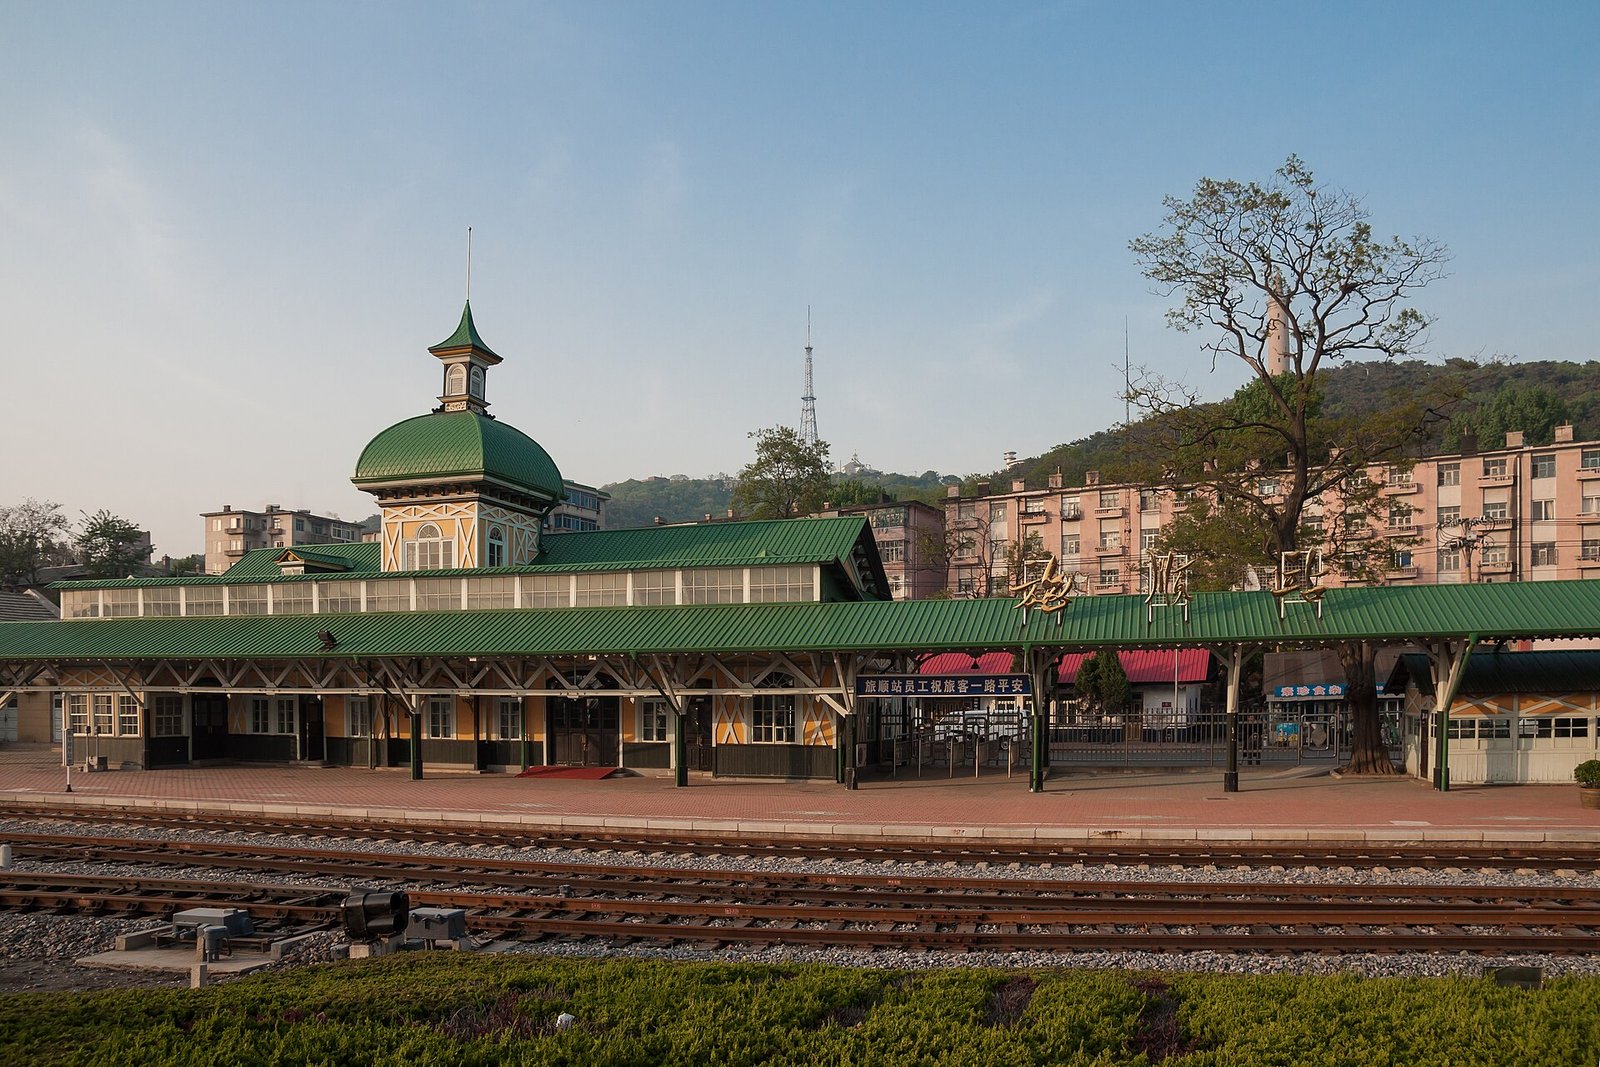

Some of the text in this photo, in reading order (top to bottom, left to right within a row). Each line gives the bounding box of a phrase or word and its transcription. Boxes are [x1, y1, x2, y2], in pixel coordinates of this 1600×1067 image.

[865, 678, 1023, 693] 旅顺站员工祝旅客一路平安
